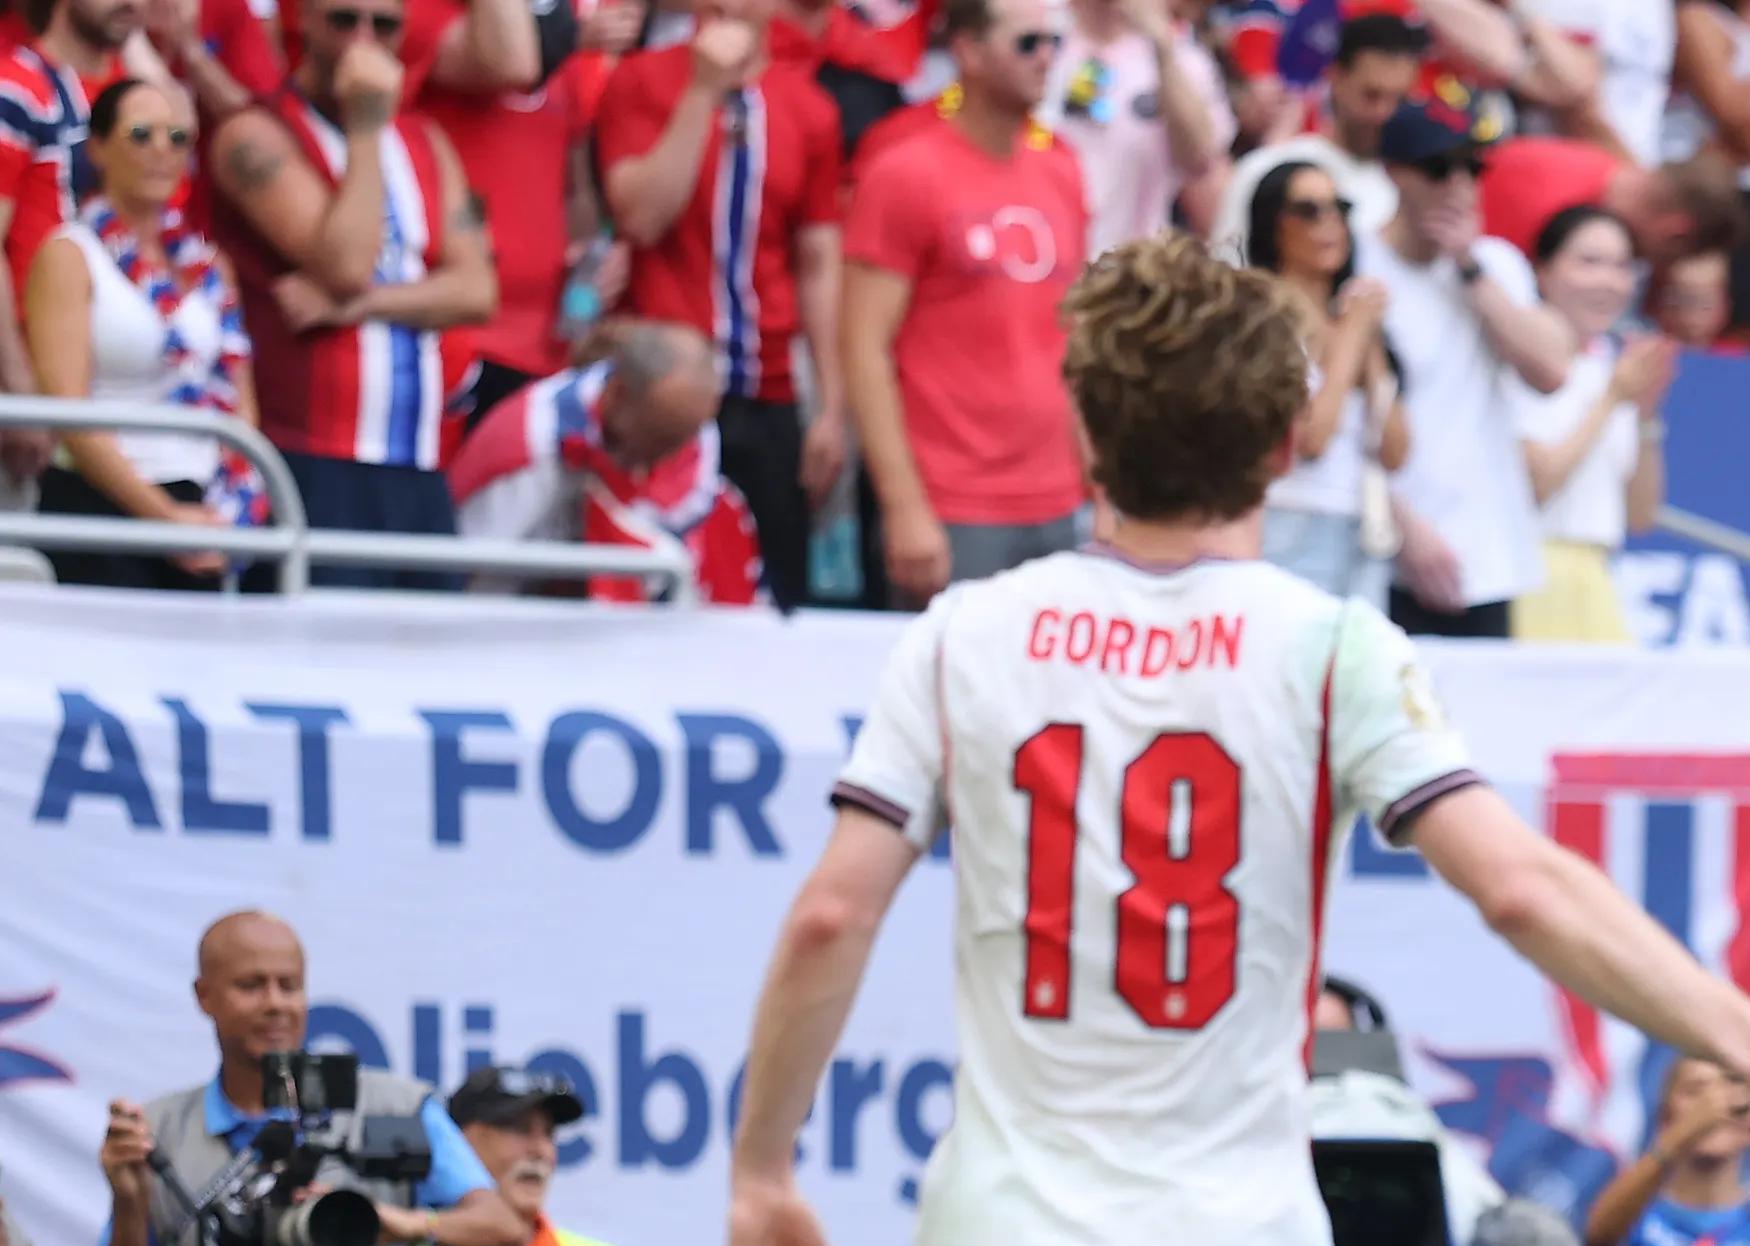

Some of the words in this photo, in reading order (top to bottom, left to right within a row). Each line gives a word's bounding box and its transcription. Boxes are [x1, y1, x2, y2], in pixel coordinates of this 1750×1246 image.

[1027, 608, 1243, 678] GORDON
[32, 688, 352, 842] ALT
[413, 708, 784, 858] FOR
[1012, 722, 1241, 1031] 18
